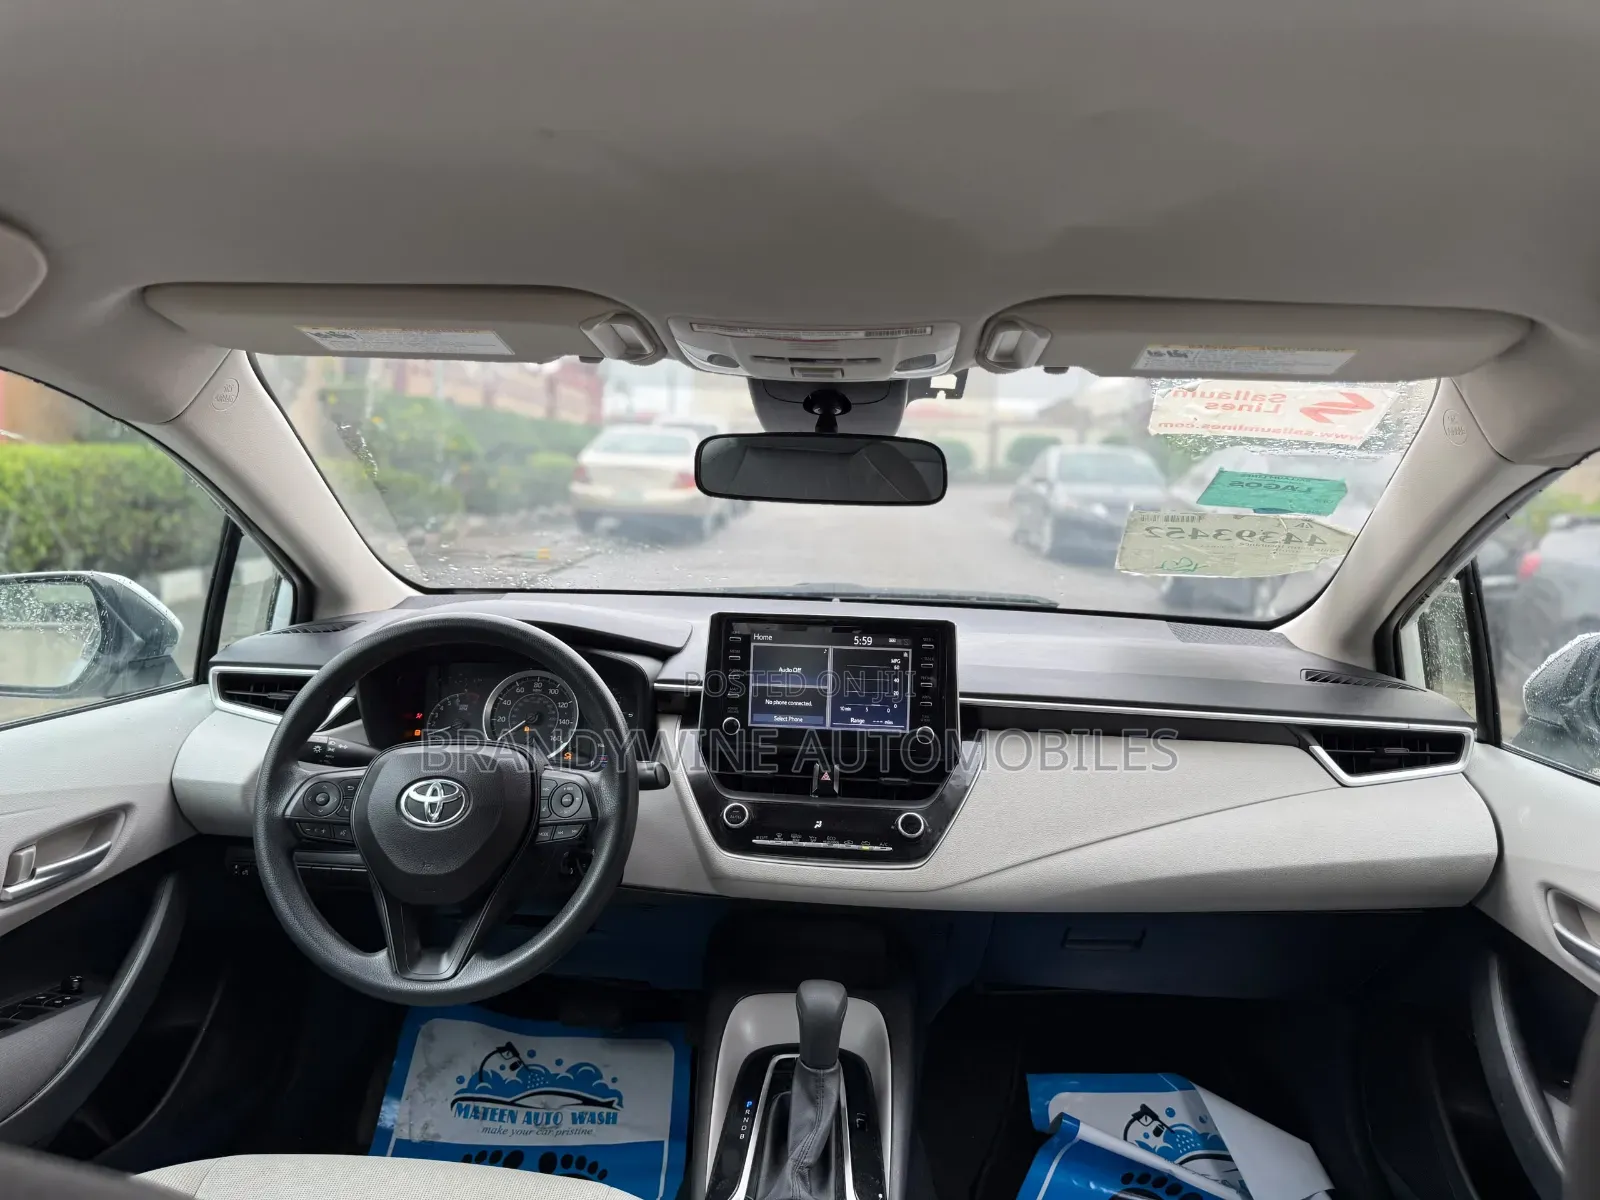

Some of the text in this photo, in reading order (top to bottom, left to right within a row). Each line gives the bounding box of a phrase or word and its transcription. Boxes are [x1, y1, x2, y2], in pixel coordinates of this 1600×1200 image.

[753, 633, 773, 641] Home
[853, 635, 873, 646] 5:59
[850, 717, 865, 725] Range
[746, 1100, 753, 1108] P
[453, 1102, 618, 1126] MATEEN AUTO WASH
[481, 1126, 509, 1136] make
[509, 1128, 533, 1138] your
[554, 1127, 593, 1138] pristine
